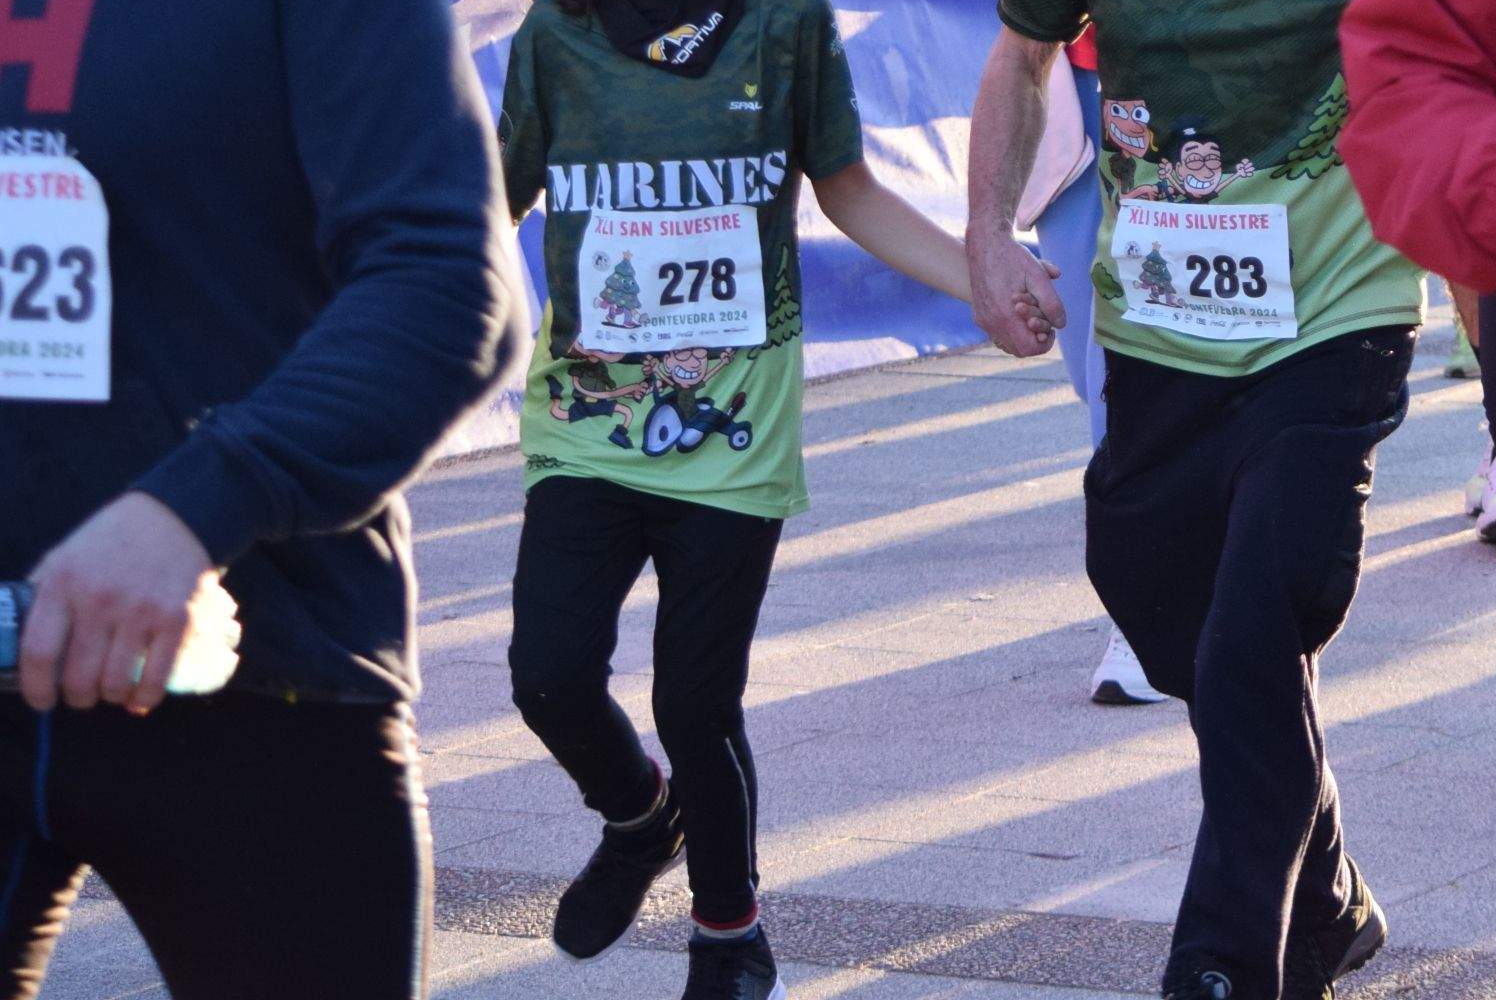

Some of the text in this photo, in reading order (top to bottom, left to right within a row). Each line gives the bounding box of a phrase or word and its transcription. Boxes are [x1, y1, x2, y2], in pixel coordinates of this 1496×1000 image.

[548, 150, 787, 212] MARINES
[594, 213, 741, 237] XLI SAN SILVESTRE
[1129, 208, 1270, 230] XLI SAN SILVESTRE
[0, 243, 95, 323] 23
[658, 257, 737, 306] 278
[1186, 254, 1268, 299] 283
[643, 310, 748, 328] PONTEVEDRA 2024
[1251, 308, 1278, 317] 2024
